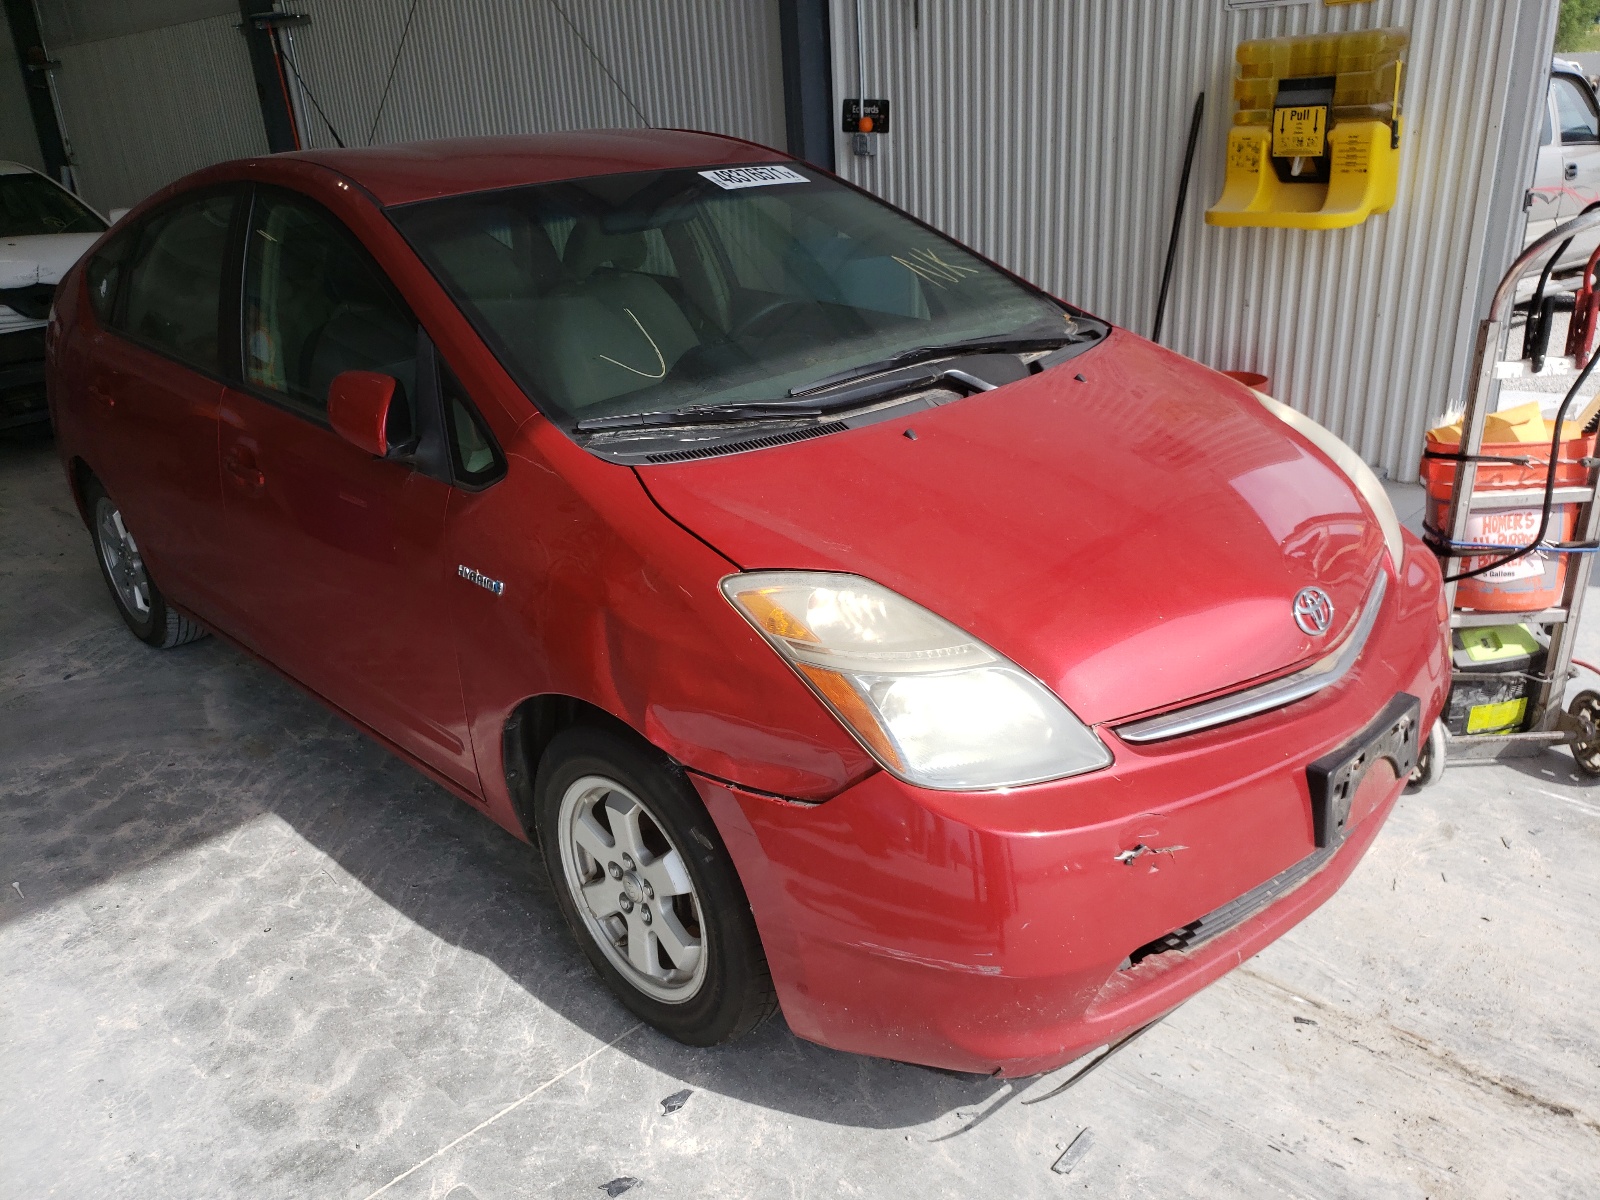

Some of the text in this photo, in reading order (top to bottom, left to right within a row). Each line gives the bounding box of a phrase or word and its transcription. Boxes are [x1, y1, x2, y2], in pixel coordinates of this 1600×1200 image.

[852, 104, 879, 114] Edards
[1290, 109, 1310, 121] Pull
[713, 167, 791, 183] 48376571
[1481, 512, 1535, 535] HOMER'S
[1489, 570, 1516, 578] Gallons
